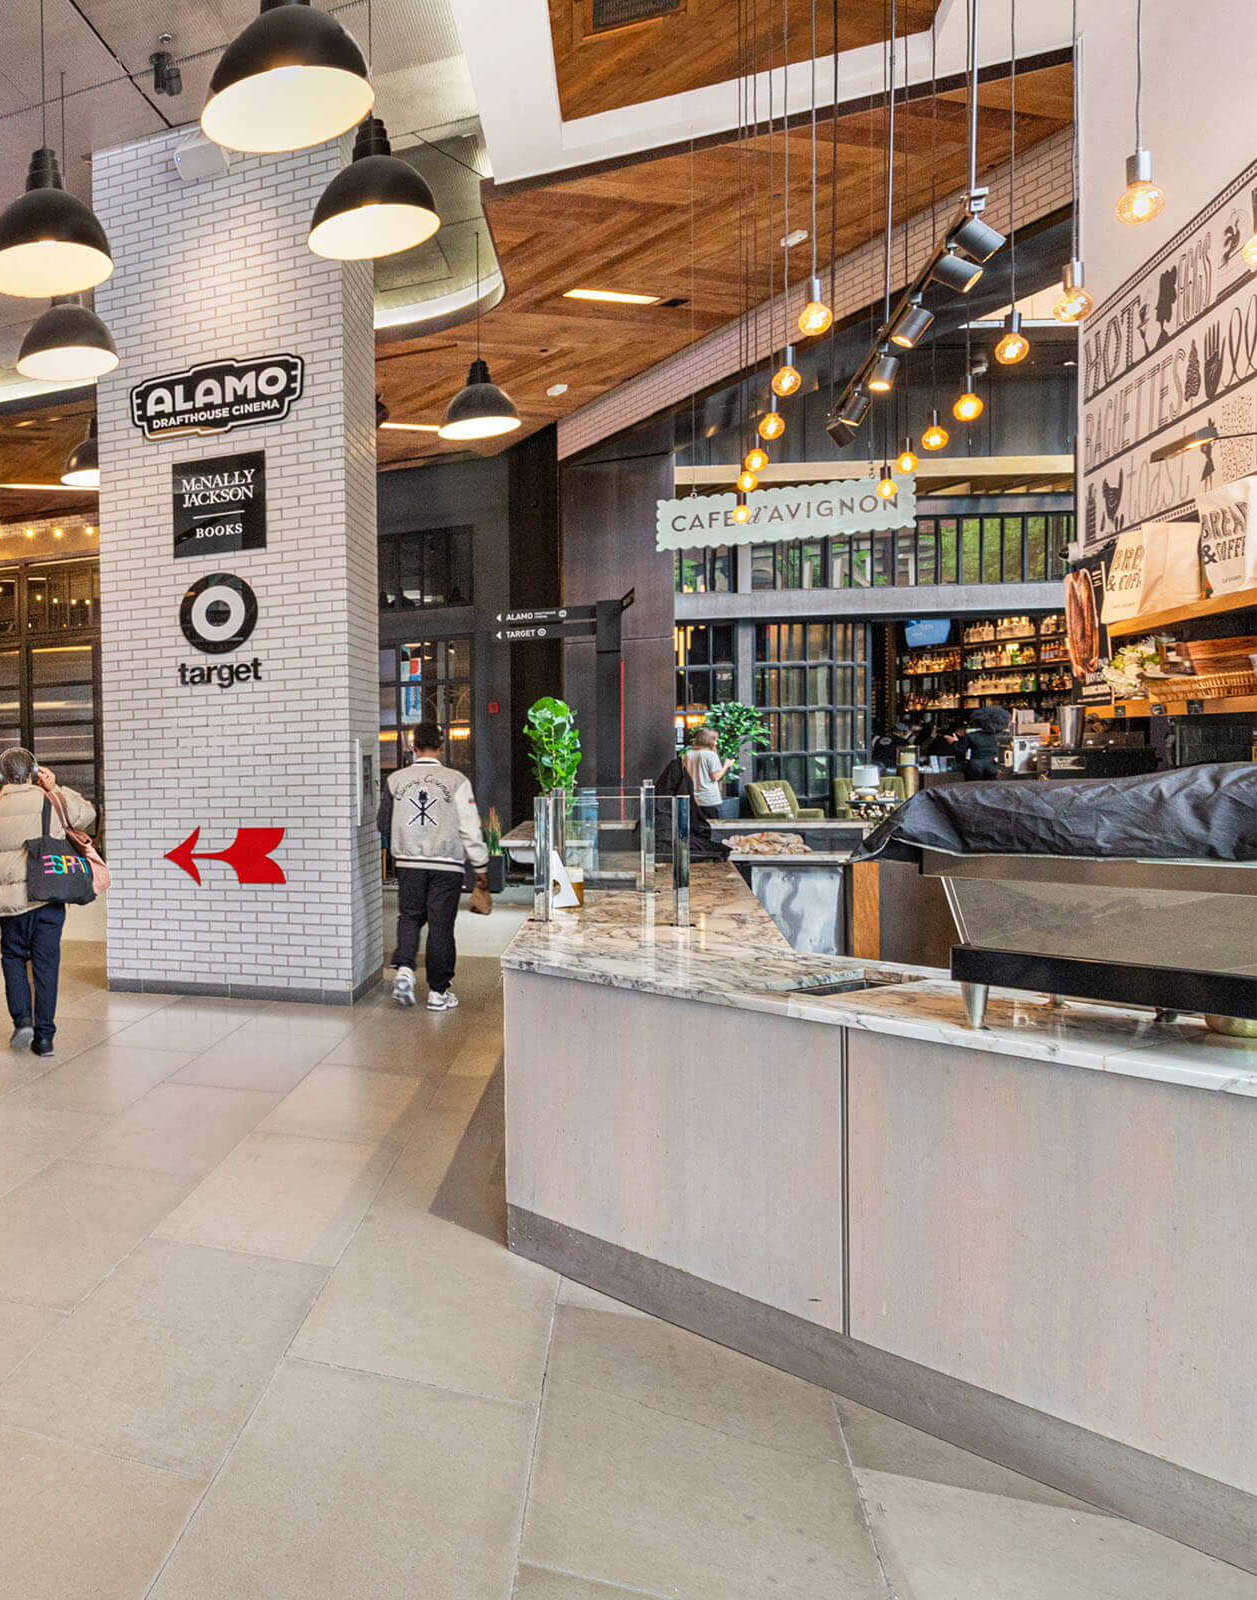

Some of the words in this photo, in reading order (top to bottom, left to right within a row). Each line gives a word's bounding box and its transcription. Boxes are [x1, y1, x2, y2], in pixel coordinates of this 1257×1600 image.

[147, 367, 287, 416] ALAMO
[152, 408, 229, 429] DRAFTHOUSE
[232, 398, 280, 416] CINEMA
[182, 469, 255, 493] McNALLY
[182, 485, 254, 508] JACKSON
[195, 523, 243, 539] BOOKS
[506, 612, 533, 621] ALAMO
[506, 629, 536, 638] TARGET
[178, 657, 262, 689] target
